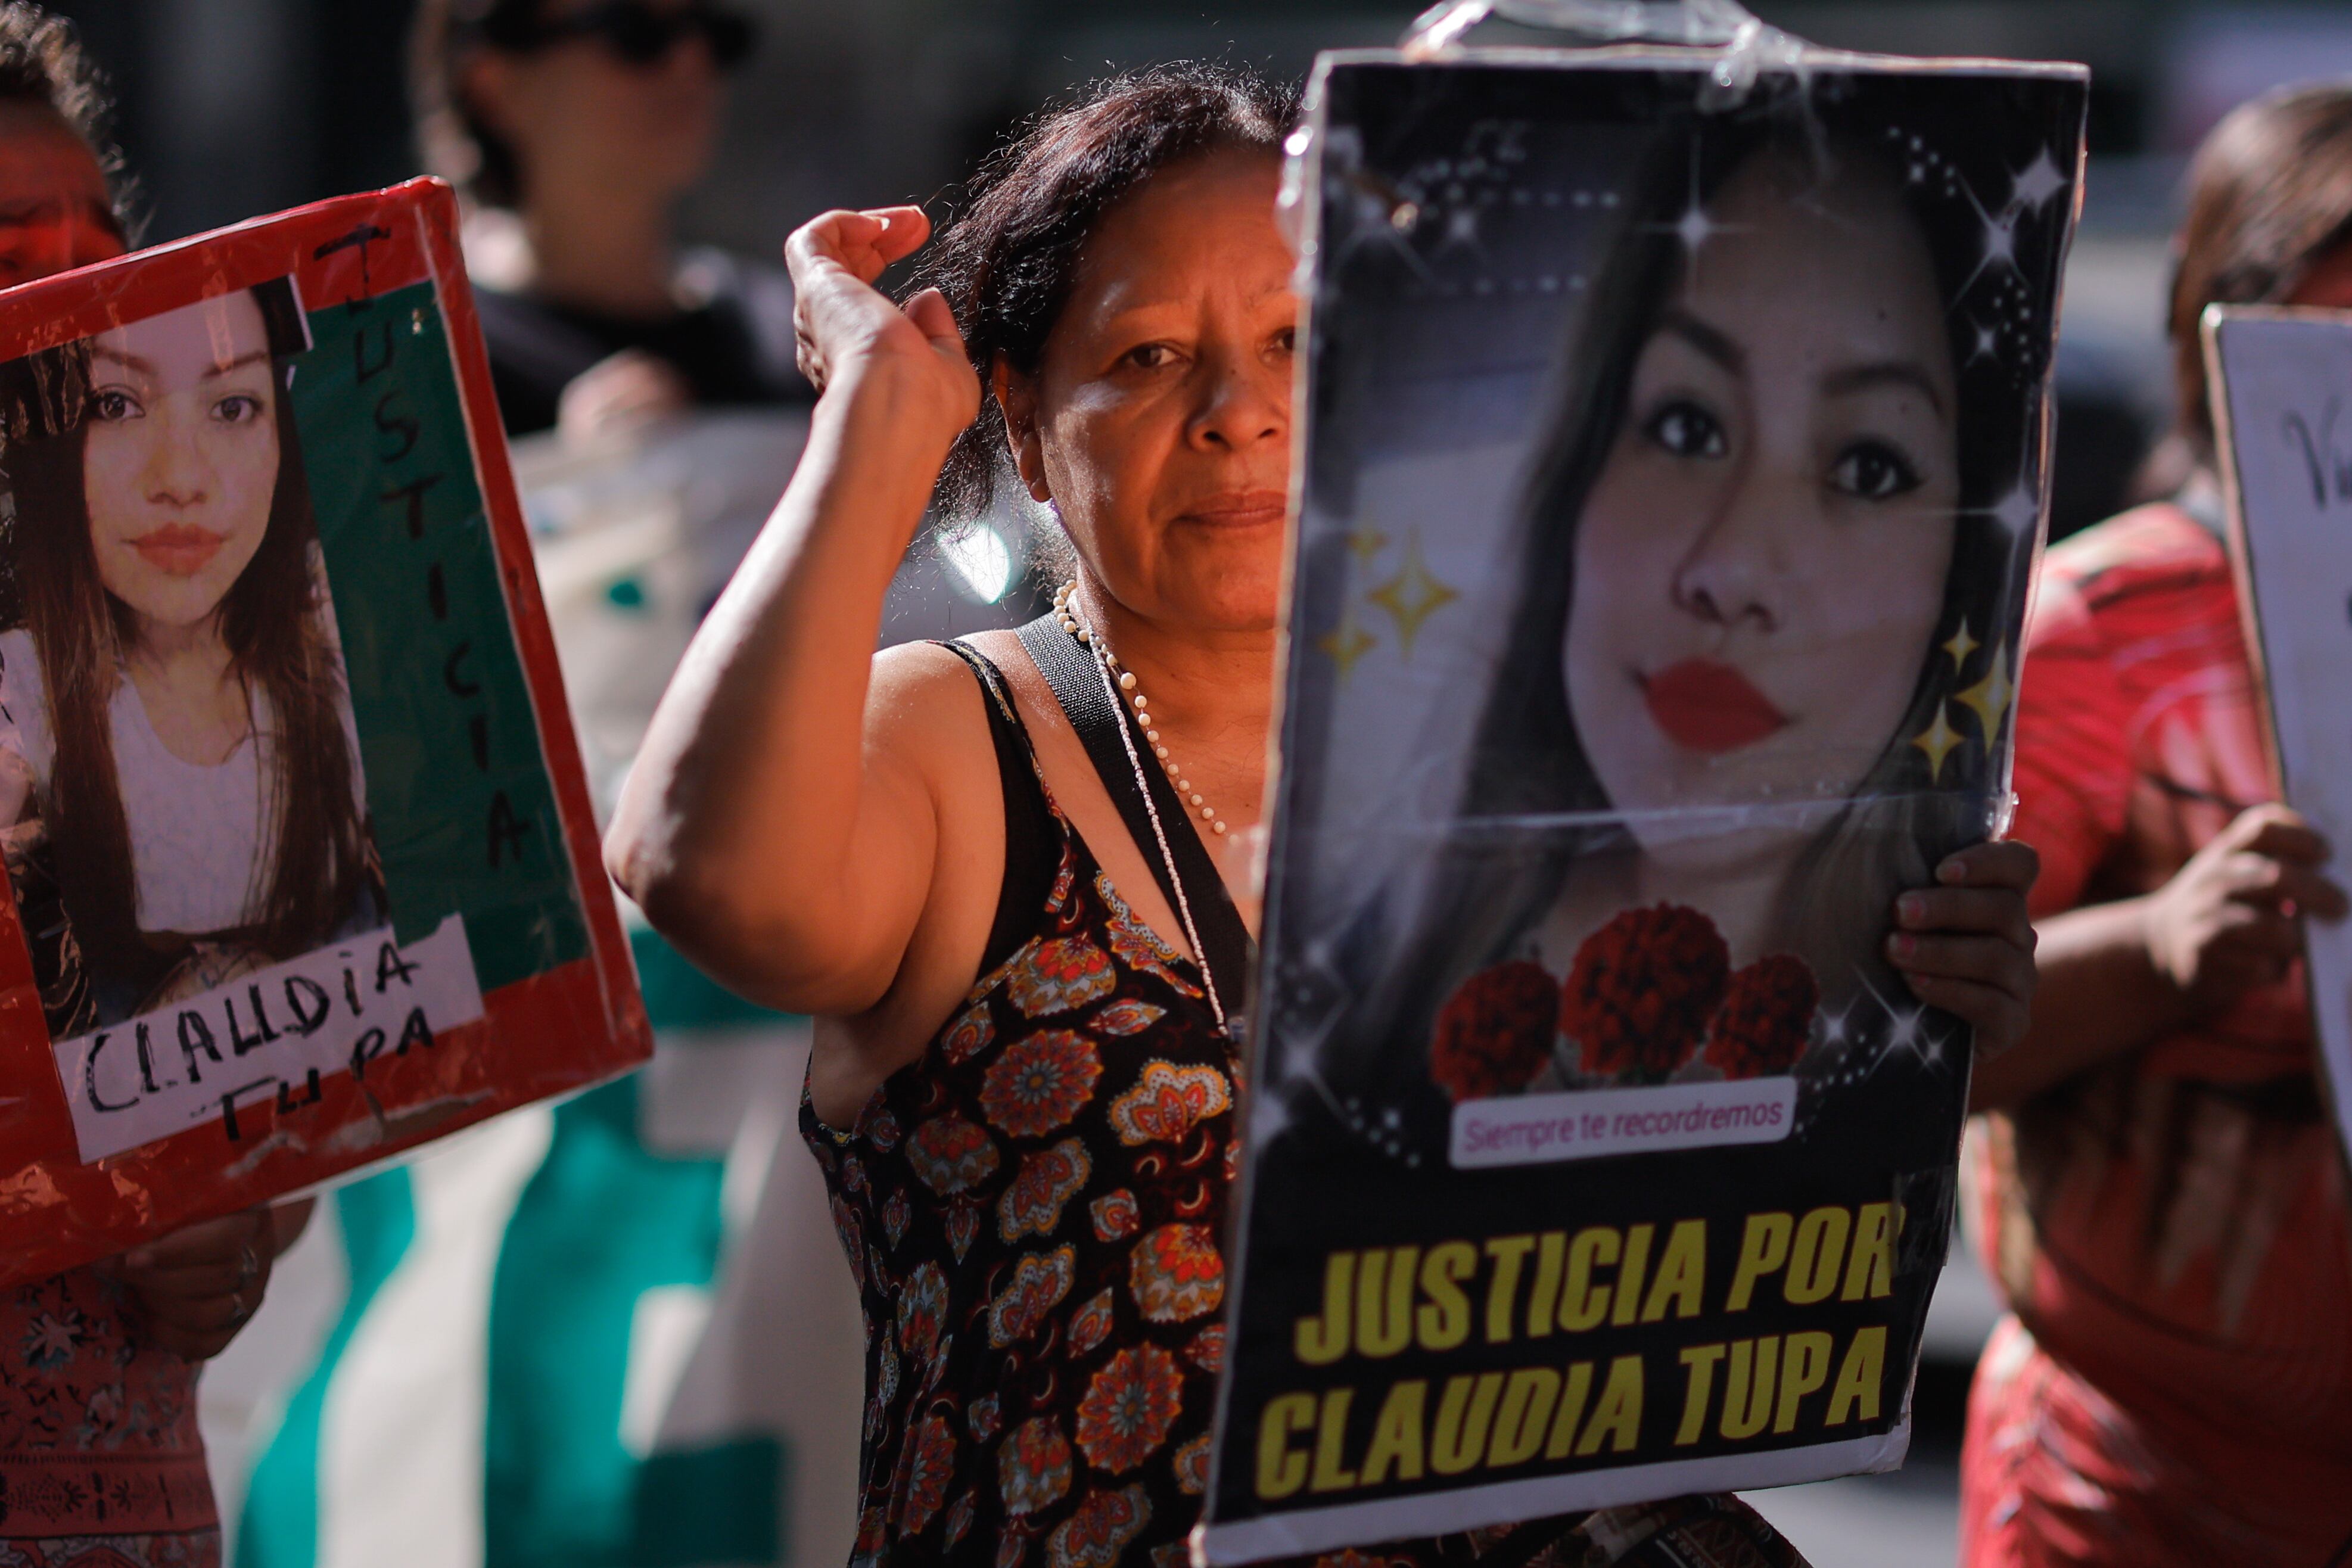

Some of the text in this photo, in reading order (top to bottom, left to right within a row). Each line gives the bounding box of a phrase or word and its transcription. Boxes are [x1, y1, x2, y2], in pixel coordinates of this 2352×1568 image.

[192, 1007, 435, 1141] TUPA
[1464, 1102, 1784, 1153] Siempre te recordremos
[1295, 1202, 1906, 1364] JUSTICIA POR
[1256, 1326, 1887, 1499] CLAUDIA TUPA
